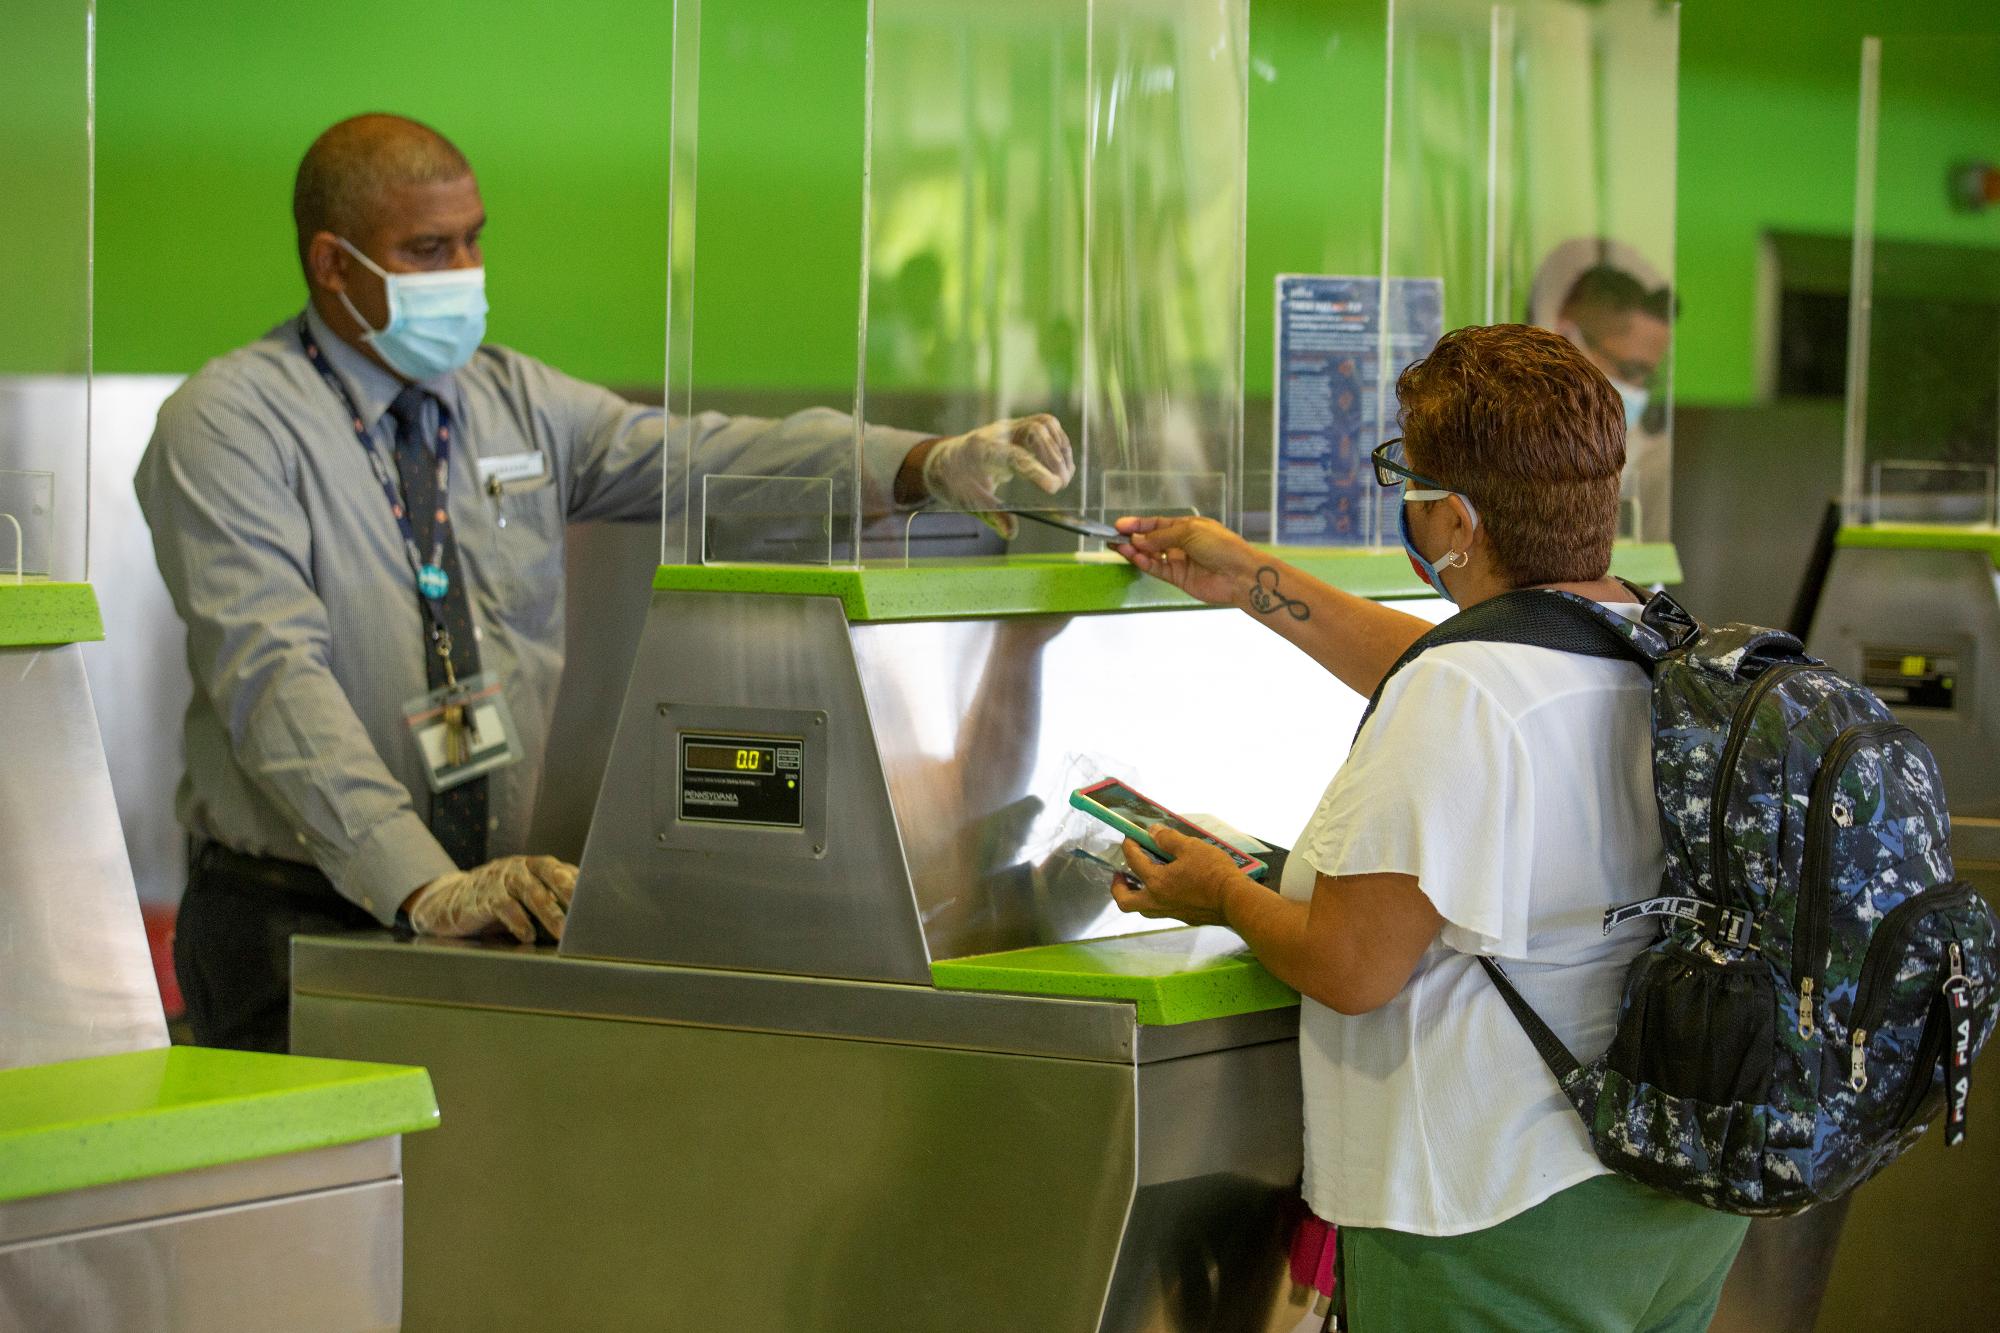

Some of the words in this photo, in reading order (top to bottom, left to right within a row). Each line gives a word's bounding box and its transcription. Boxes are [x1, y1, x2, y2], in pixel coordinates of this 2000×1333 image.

[737, 750, 759, 769] 0.0
[684, 790, 739, 801] PENNSYLVANIA
[1639, 899, 1700, 918] FILA
[1952, 987, 1968, 1008] FI
[1956, 1019, 1969, 1066] FILA
[1953, 1076, 1968, 1122] FILA
